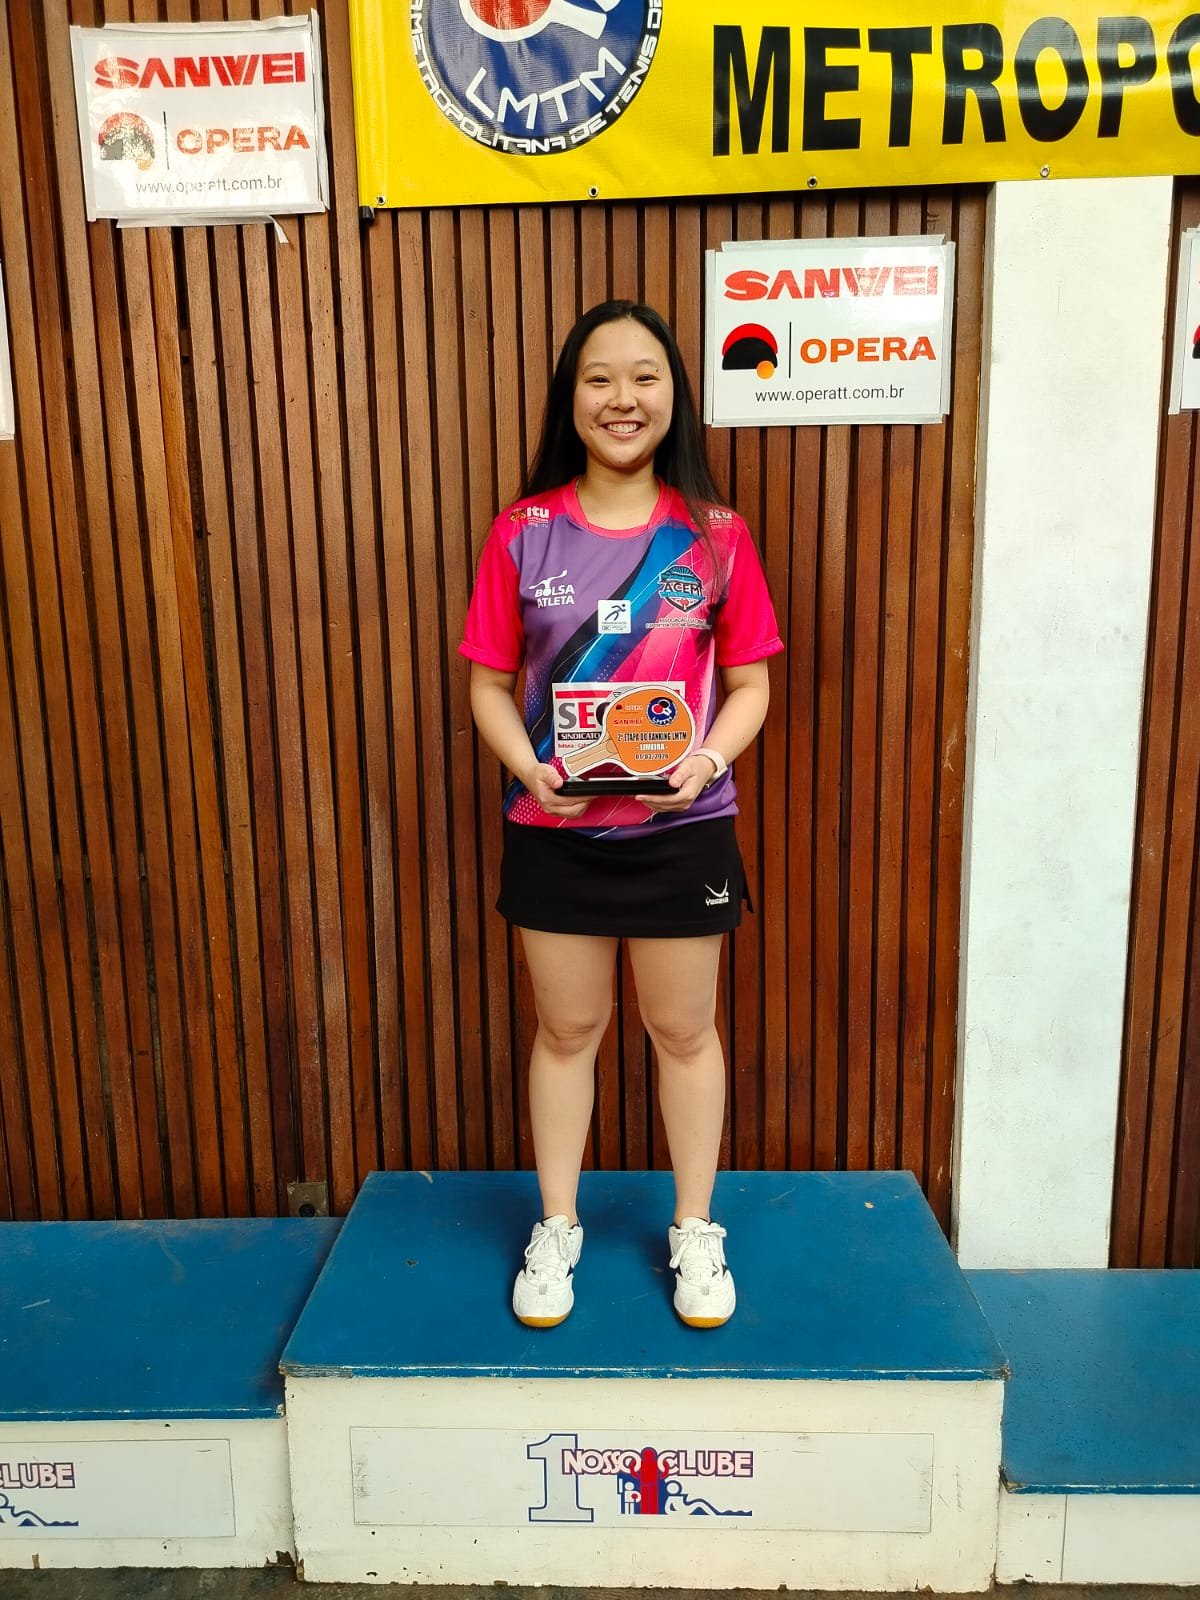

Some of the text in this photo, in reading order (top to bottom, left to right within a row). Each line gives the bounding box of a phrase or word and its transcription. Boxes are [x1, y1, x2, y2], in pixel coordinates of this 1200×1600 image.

[94, 52, 306, 89] SANWEI
[465, 46, 627, 130] LMTM
[176, 125, 311, 155] OPERA
[723, 266, 939, 301] SANWEI
[800, 336, 937, 364] OPERA
[755, 384, 905, 403] www.operatt.com.br
[535, 585, 576, 598] BOLSA
[537, 596, 576, 609] ATLETA
[663, 582, 702, 597] ACEM
[0, 1462, 76, 1489] LUBE
[562, 1448, 754, 1478] NOSSO CLUBE
